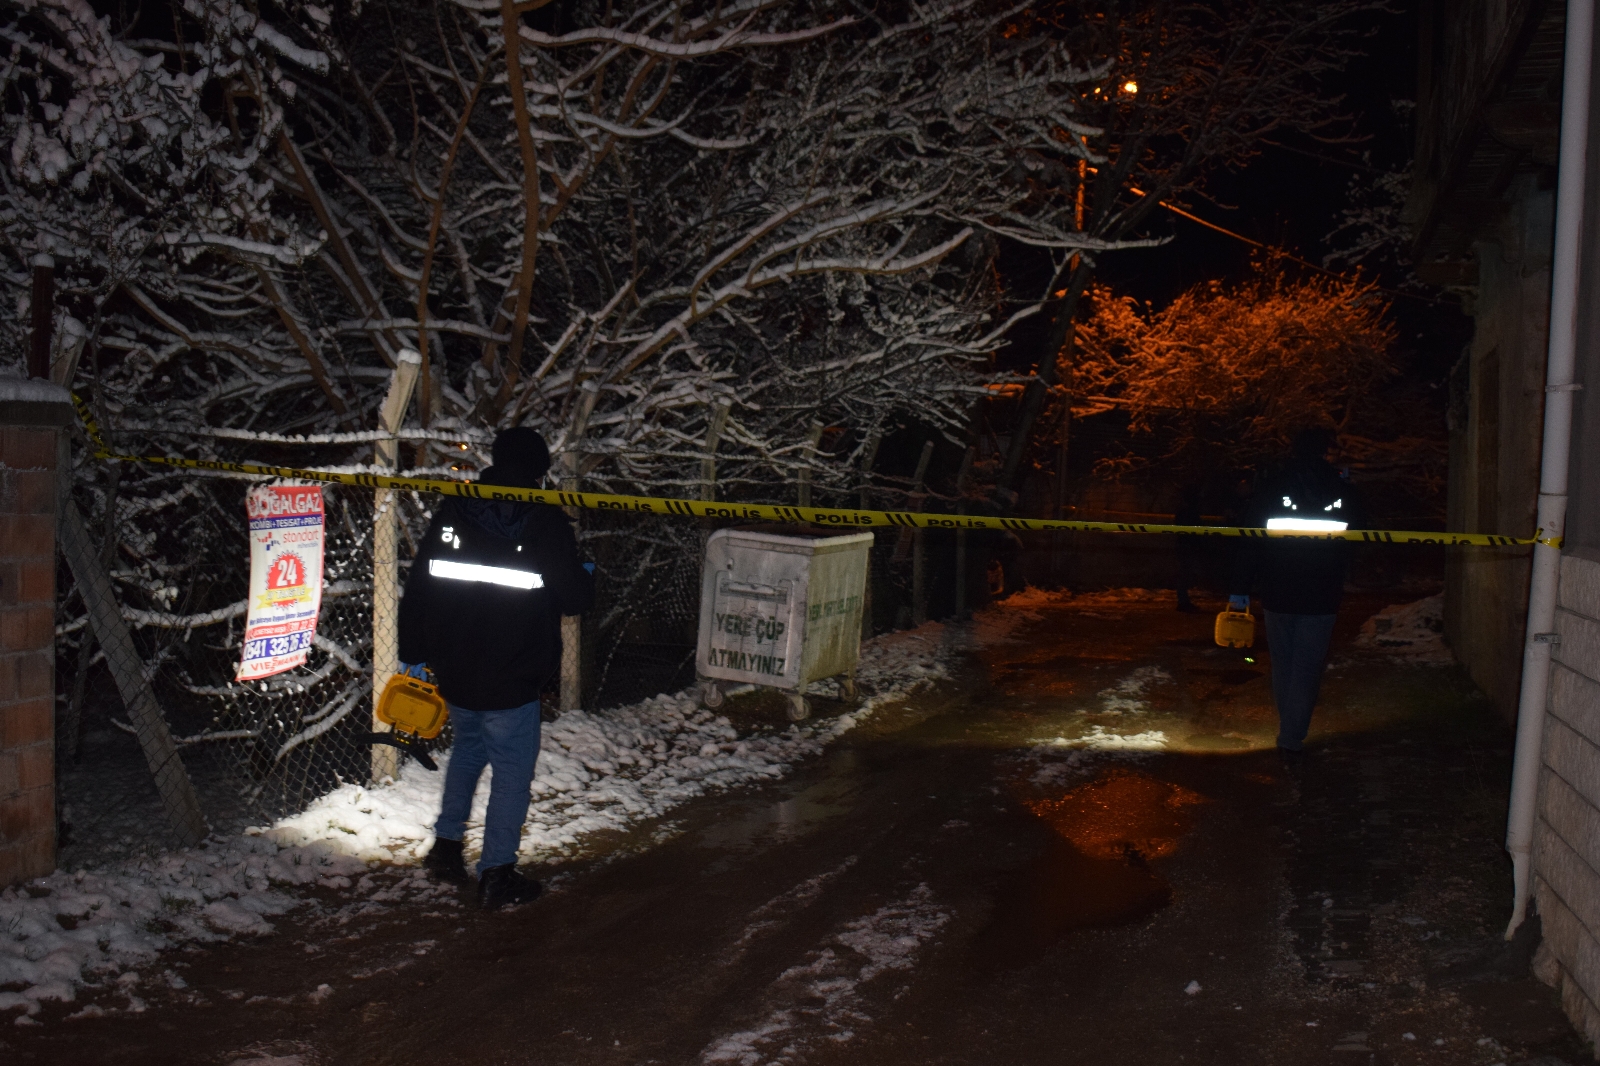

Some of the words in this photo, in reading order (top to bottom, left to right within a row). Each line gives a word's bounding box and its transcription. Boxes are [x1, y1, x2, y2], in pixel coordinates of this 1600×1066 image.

[705, 507, 762, 519] POLİS
[815, 513, 872, 525] POLİS
[927, 519, 987, 528] POLİS
[277, 559, 298, 587] 24
[716, 613, 752, 637] YERE
[756, 616, 785, 644] ÇÜP
[709, 648, 786, 677] ATMAYINIZ
